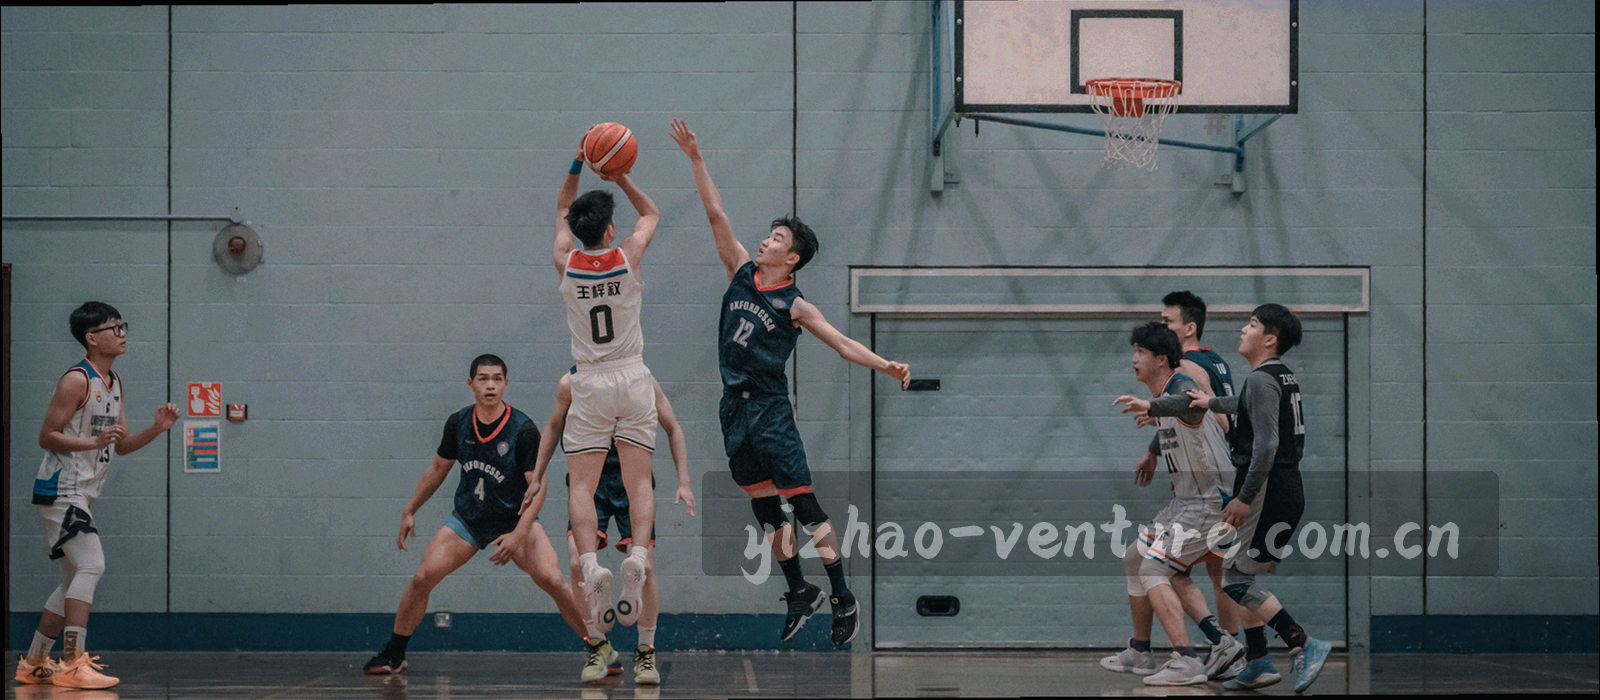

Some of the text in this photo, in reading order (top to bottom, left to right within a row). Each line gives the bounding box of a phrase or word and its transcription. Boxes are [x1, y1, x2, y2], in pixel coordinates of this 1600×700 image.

[590, 304, 615, 345] 0
[733, 317, 755, 348] 12
[1164, 452, 1178, 475] 11
[474, 477, 486, 501] 4
